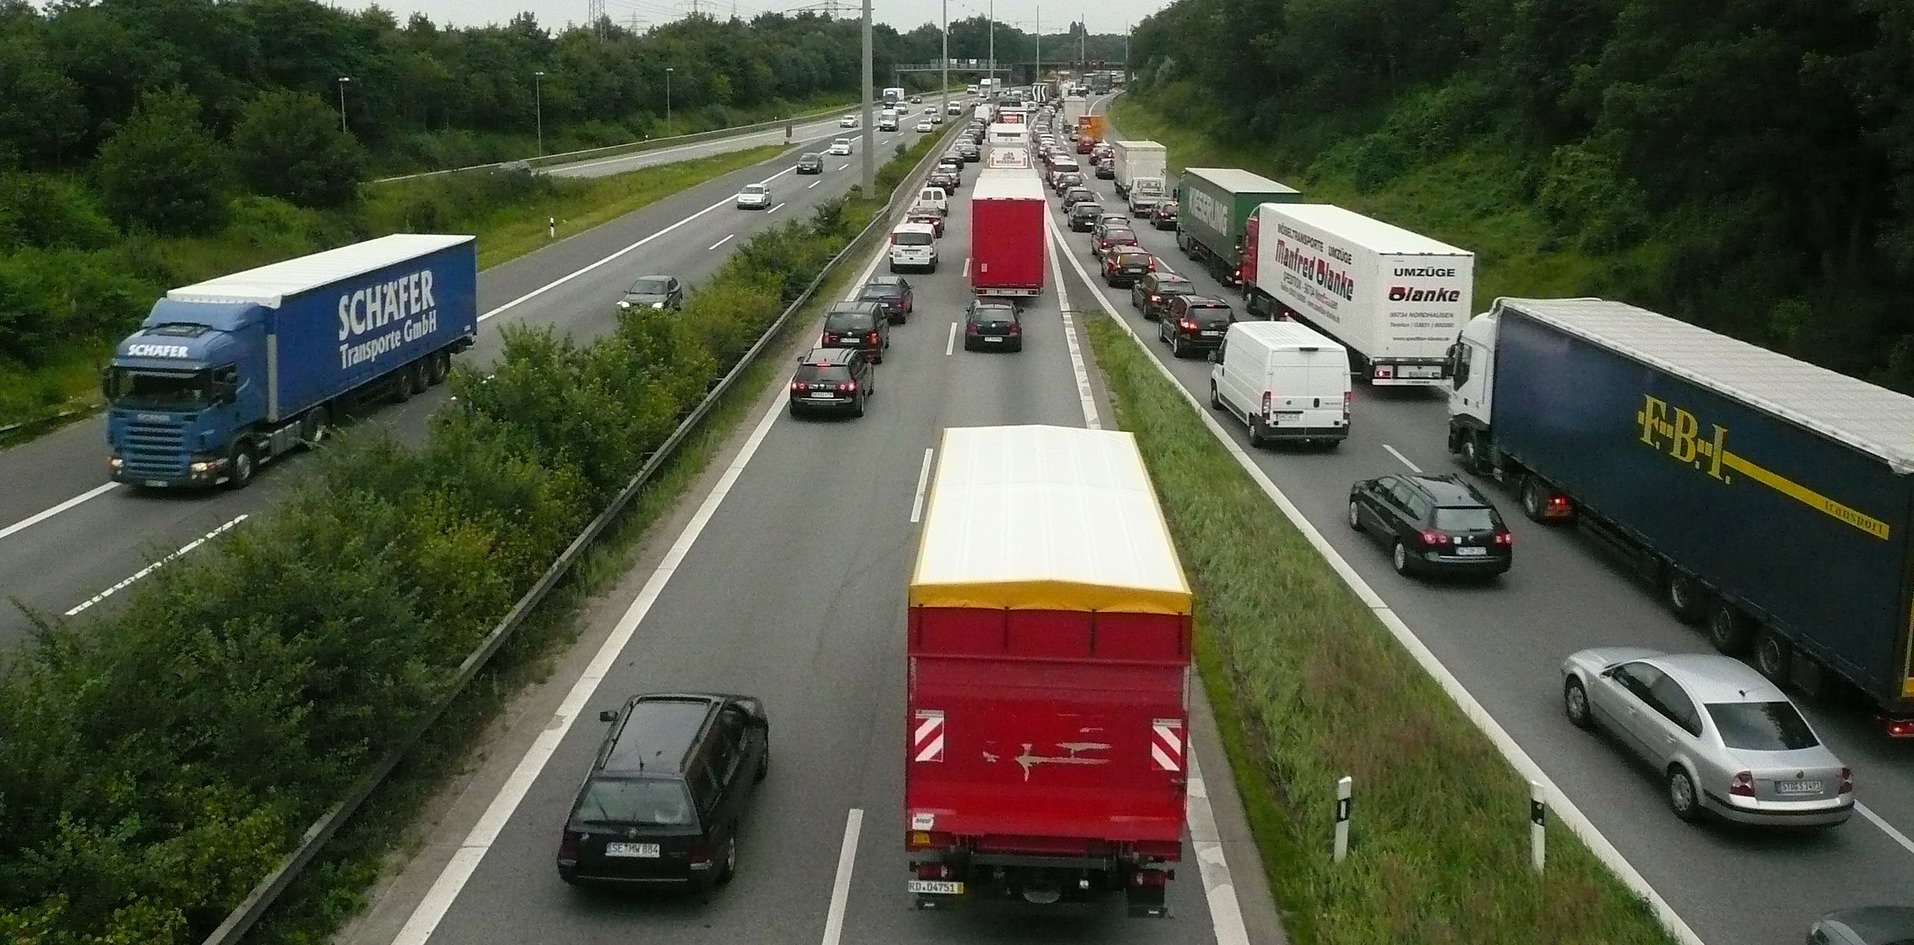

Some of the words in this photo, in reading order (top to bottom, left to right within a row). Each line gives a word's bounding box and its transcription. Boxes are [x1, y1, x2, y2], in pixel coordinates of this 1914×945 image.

[1275, 239, 1316, 281] Manfred
[1316, 258, 1354, 302] Blanke
[1328, 246, 1353, 266] UMZÜGE
[1394, 265, 1456, 277] UMZÜGE
[338, 269, 436, 341] SCHÄFER
[1388, 286, 1461, 302] Blanke
[127, 343, 190, 358] SCHÄFER
[339, 330, 401, 370] Transporte
[403, 309, 437, 343] GmbH
[1824, 499, 1885, 537] transport
